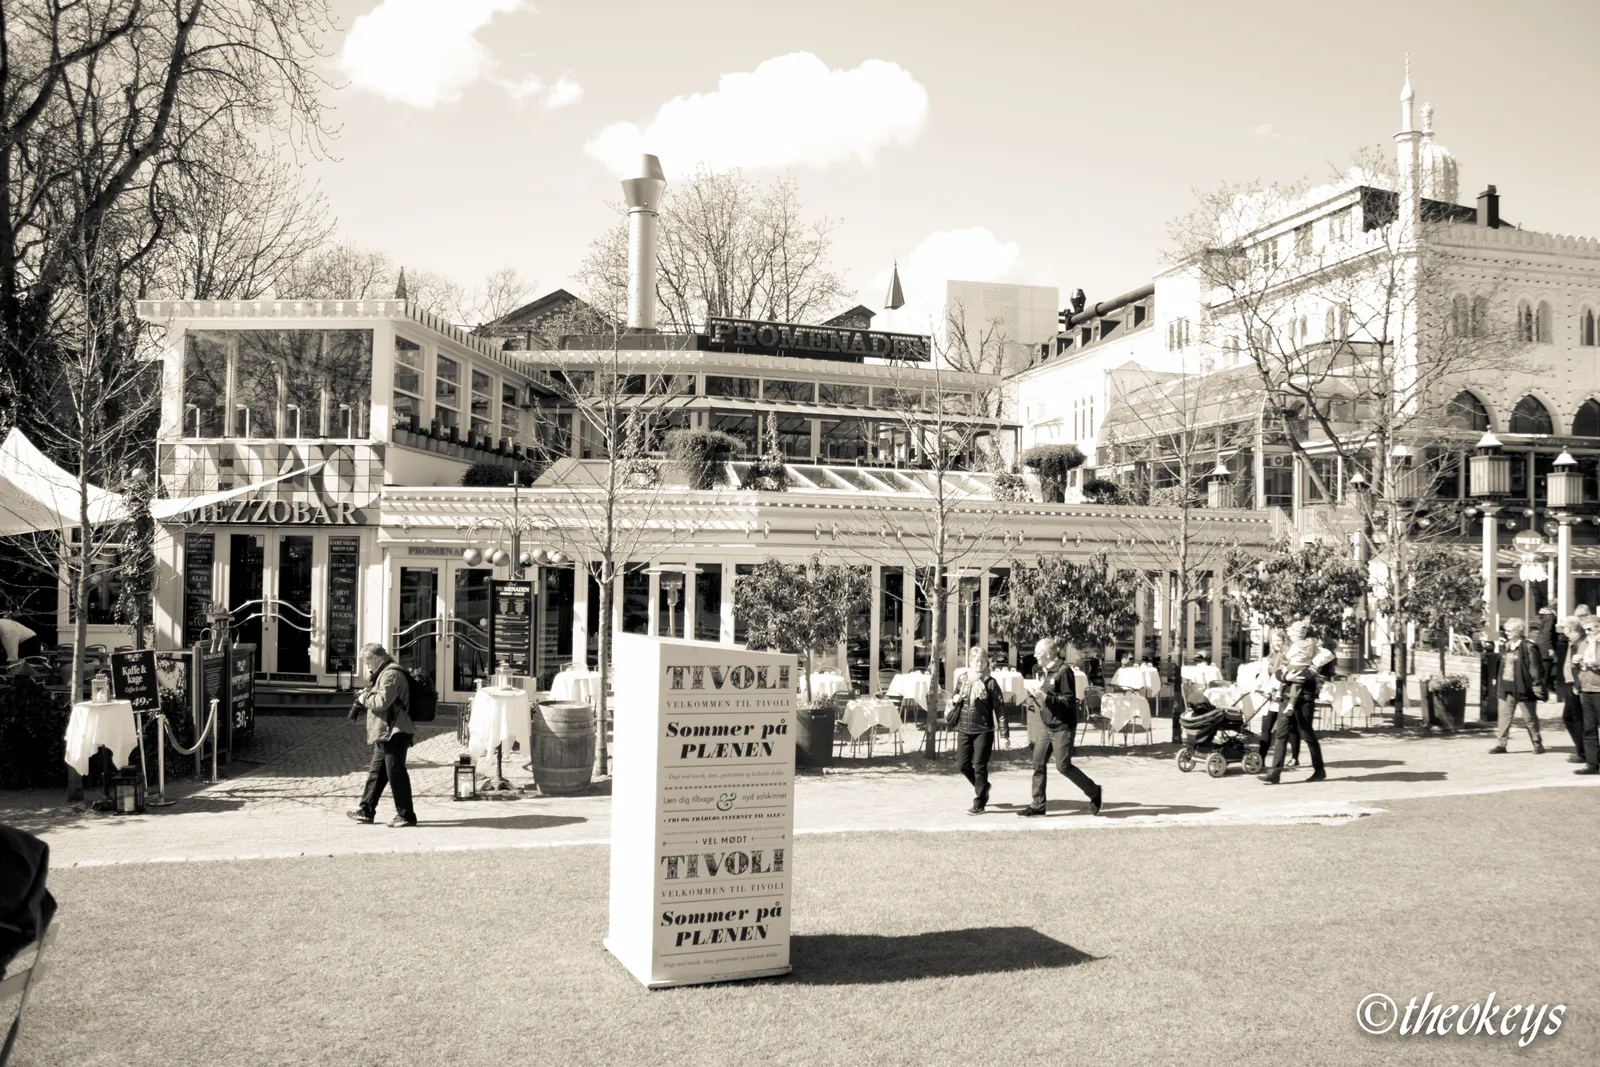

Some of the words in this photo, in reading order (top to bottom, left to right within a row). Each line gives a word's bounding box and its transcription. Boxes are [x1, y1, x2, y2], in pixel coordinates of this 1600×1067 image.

[711, 320, 931, 360] PROMENADEN
[181, 499, 359, 525] MEZZOBAR
[122, 665, 140, 676] Kaffe
[140, 665, 147, 674] &
[127, 674, 143, 685] kage
[666, 665, 791, 690] TIVOLI
[132, 697, 153, 707] 49,-
[667, 700, 730, 709] VELKOMMEN
[735, 700, 752, 708] TIL
[666, 721, 754, 738] Sommer
[760, 718, 788, 740] på
[680, 741, 775, 759] PLÆNEN
[678, 796, 690, 805] dig
[692, 795, 715, 804] tilbage
[716, 792, 737, 812] &
[742, 793, 754, 802] nyd
[756, 792, 787, 800] solskinnet
[702, 837, 718, 845] VEL
[721, 836, 747, 844] MØDT
[660, 848, 785, 880] TIVOLI
[661, 886, 726, 898] VELKOMMEN
[750, 882, 784, 892] TIVOLI
[660, 907, 749, 927] Sommer
[755, 901, 782, 923] på
[675, 924, 769, 947] PLÆNEN
